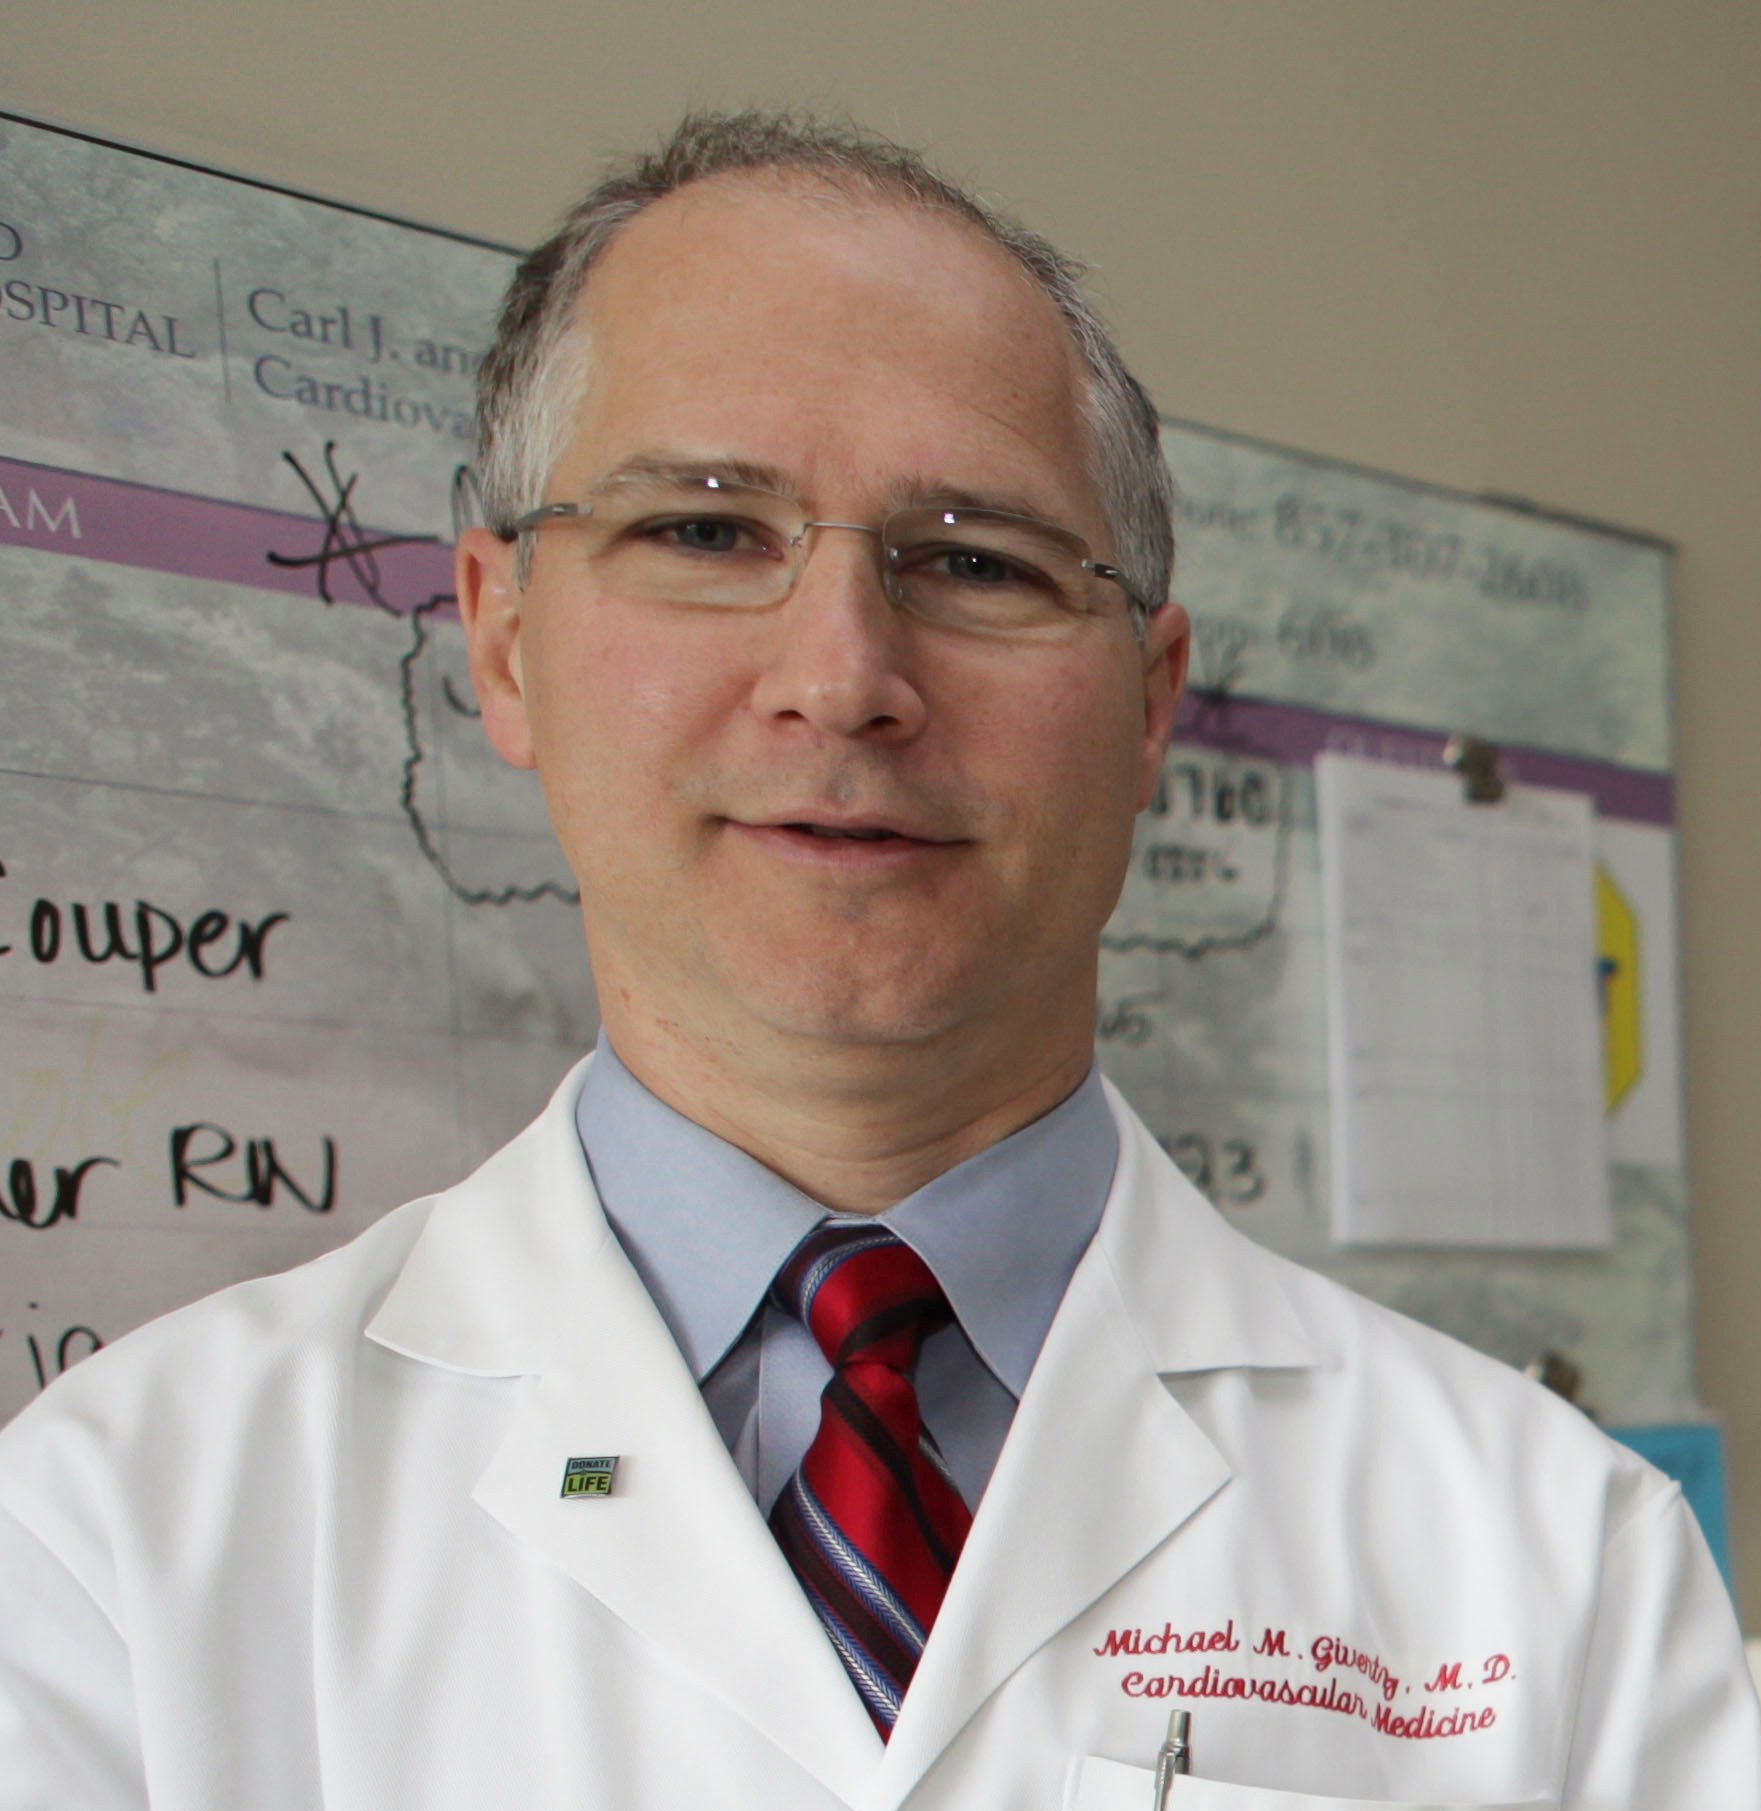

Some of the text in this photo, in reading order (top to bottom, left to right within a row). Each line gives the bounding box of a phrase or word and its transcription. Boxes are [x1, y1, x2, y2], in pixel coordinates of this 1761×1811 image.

[0, 280, 196, 359] SPITAL
[248, 288, 352, 349] Carl
[368, 314, 399, 364] J.
[253, 354, 478, 440] Cardiova
[0, 857, 289, 992] ouper
[0, 1122, 335, 1229] er RN
[567, 1475, 610, 1493] LIFE
[571, 1460, 611, 1470] DONATE
[1093, 1619, 1240, 1657] Michael
[1121, 1664, 1497, 1741] Cardiovascular Medicine
